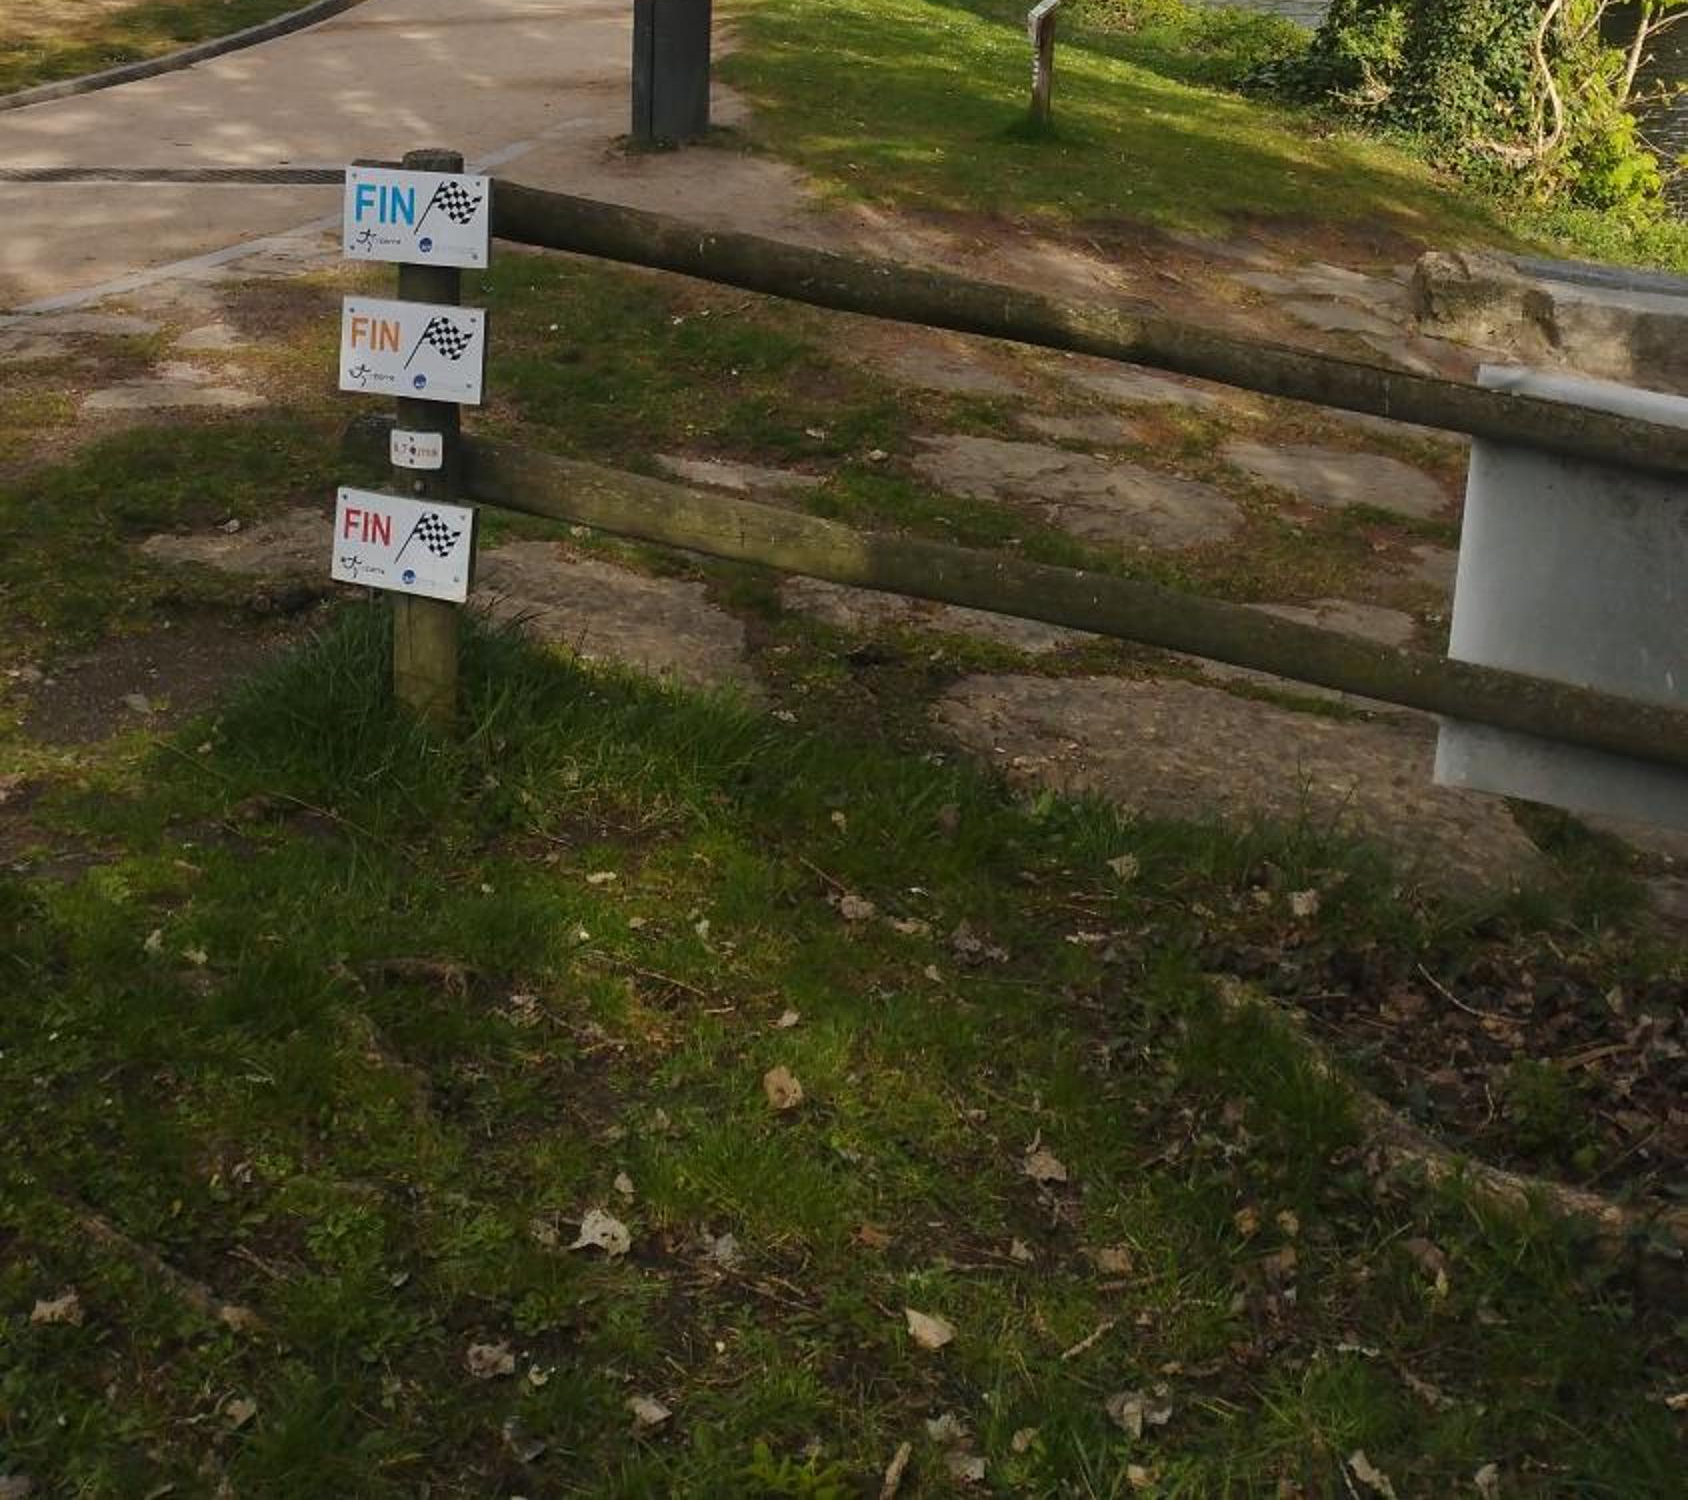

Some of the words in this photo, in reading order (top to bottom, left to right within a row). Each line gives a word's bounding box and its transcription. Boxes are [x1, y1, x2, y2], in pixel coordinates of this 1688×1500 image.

[355, 183, 415, 225] FIN
[351, 316, 400, 352] FIN
[344, 508, 391, 546] FIN
